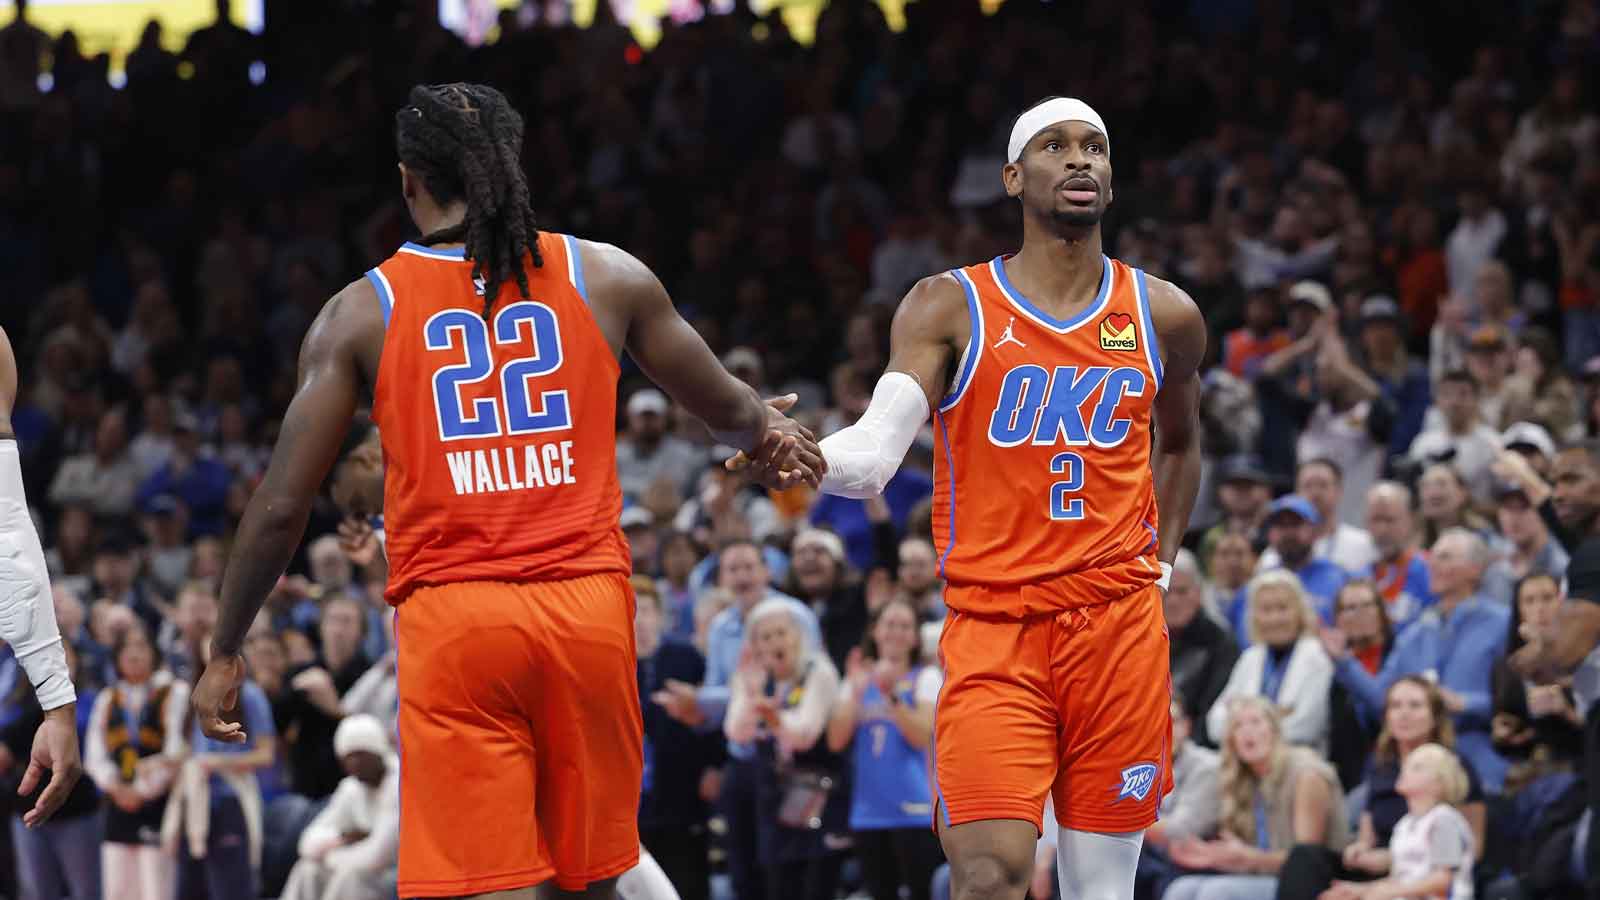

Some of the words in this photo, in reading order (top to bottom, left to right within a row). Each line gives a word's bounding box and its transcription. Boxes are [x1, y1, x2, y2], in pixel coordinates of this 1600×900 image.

[423, 300, 572, 442] 22
[987, 364, 1146, 448] OKC
[446, 440, 576, 495] WALLACE
[1050, 452, 1084, 520] 2
[1120, 768, 1151, 795] OKC
